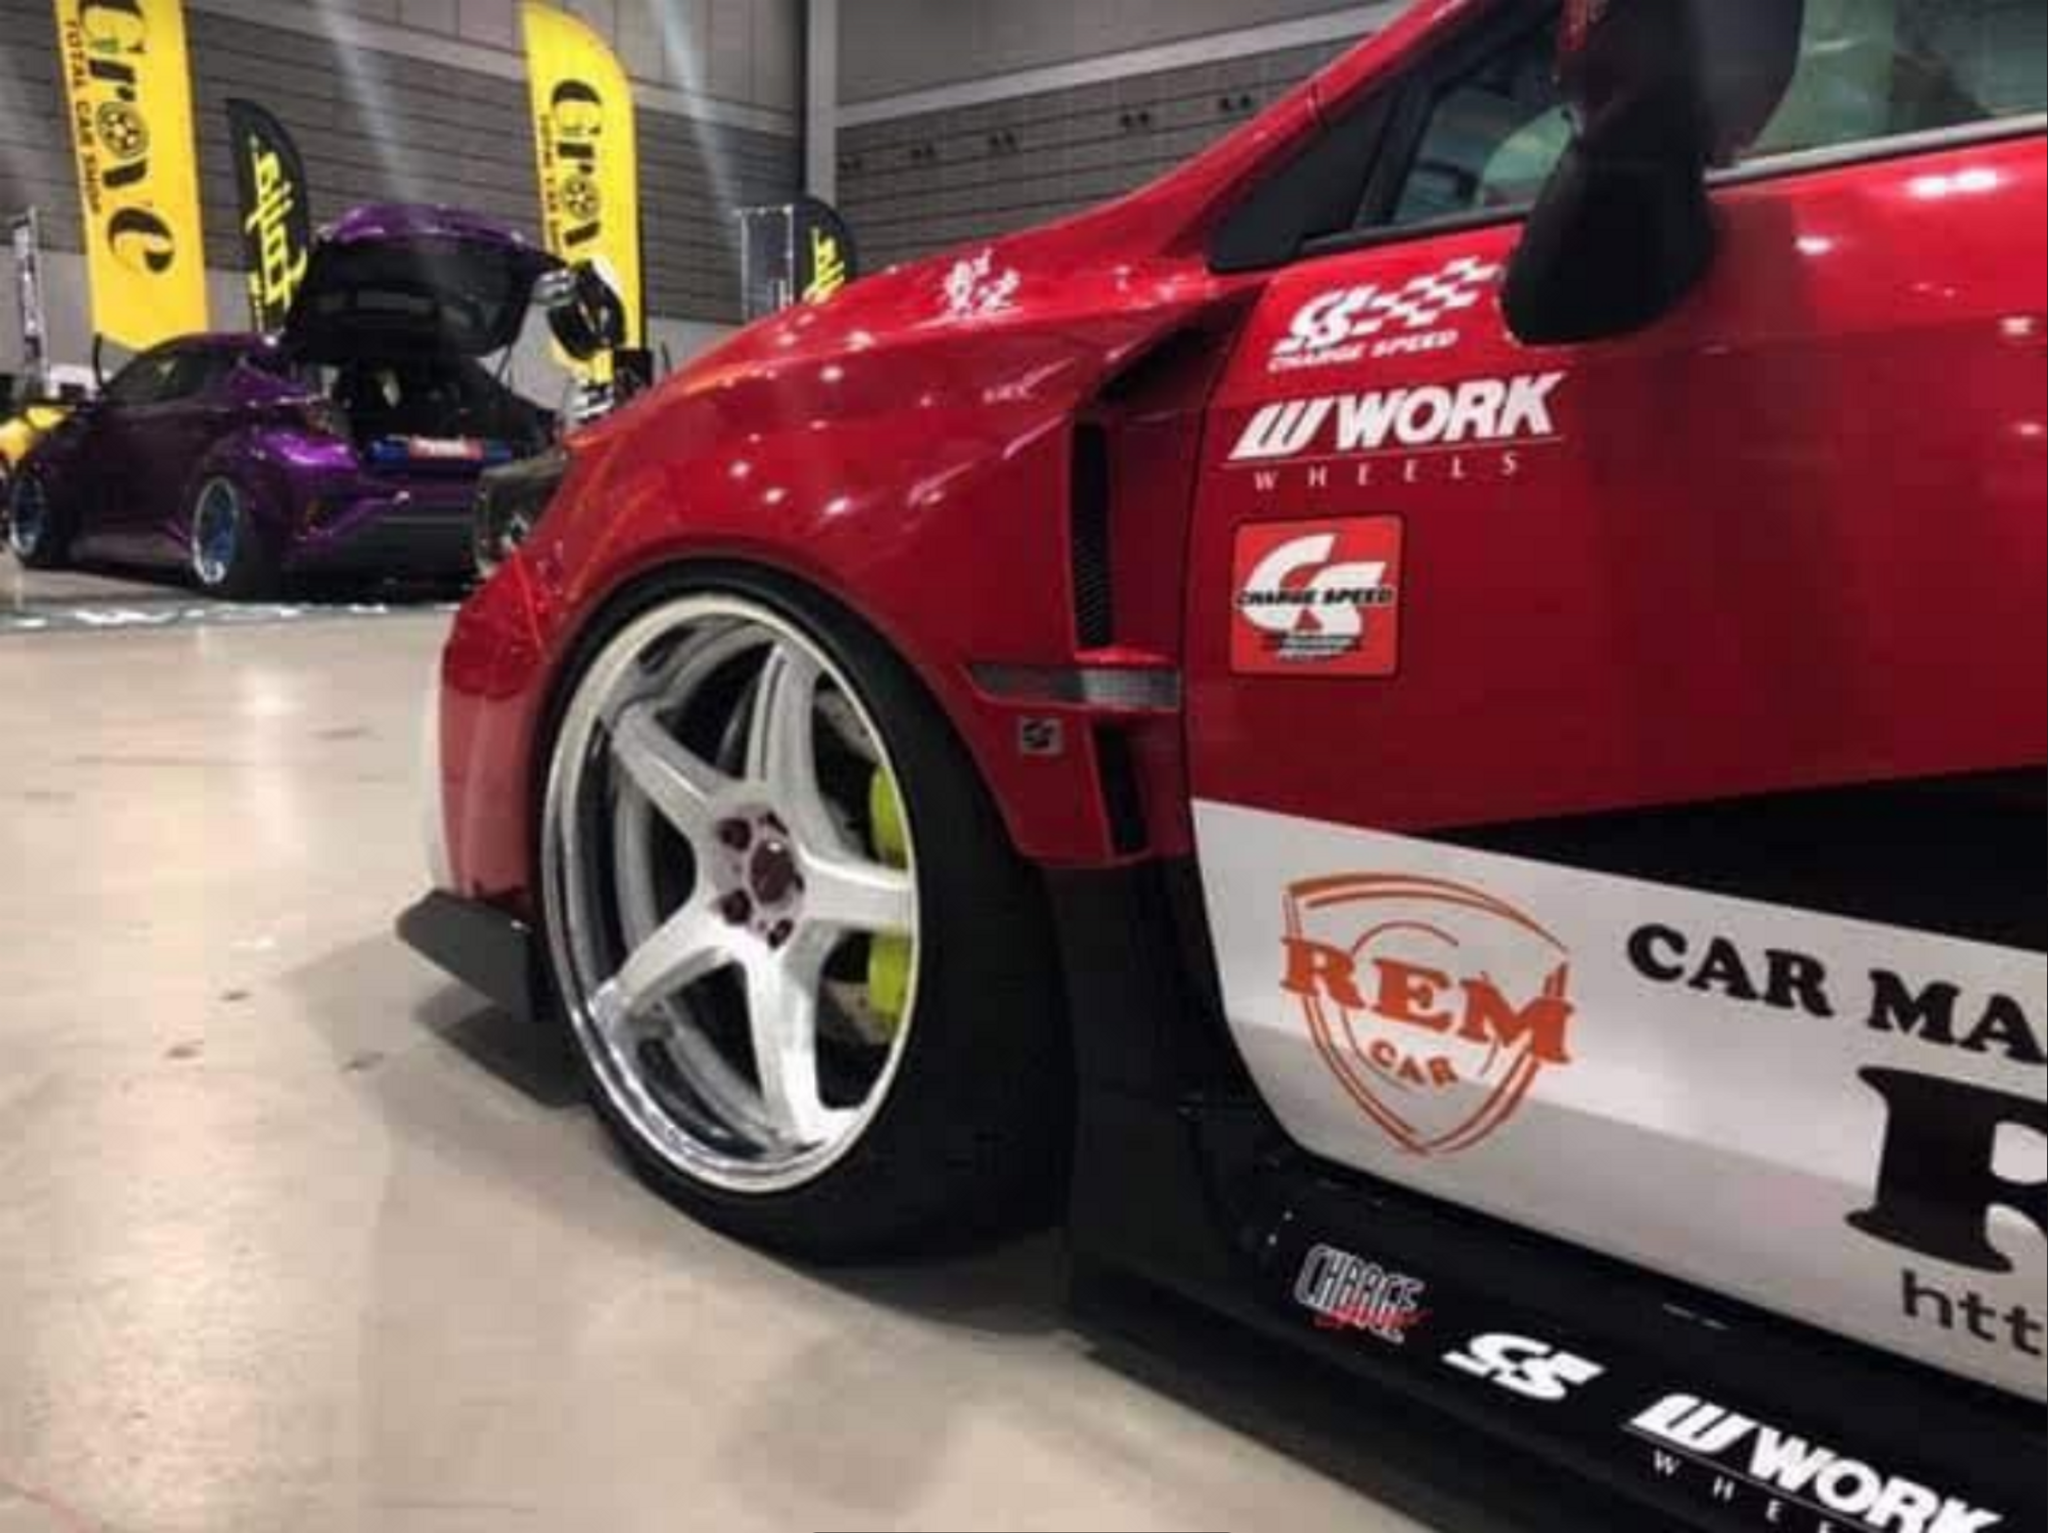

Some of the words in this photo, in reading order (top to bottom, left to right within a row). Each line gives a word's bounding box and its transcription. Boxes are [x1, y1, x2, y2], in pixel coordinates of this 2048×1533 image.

[76, 100, 95, 147] CAR
[552, 79, 601, 272] Grov
[1370, 329, 1459, 358] SPEED
[1335, 372, 1567, 450] WORK
[1254, 453, 1518, 491] WHEELS
[1236, 587, 1319, 613] CHARGE
[1322, 584, 1396, 606] SPEED
[1280, 935, 1574, 1065] REM
[1627, 923, 1835, 1018] CAR
[1368, 1040, 1459, 1087] CAR
[1748, 1425, 2003, 1533] WORK
